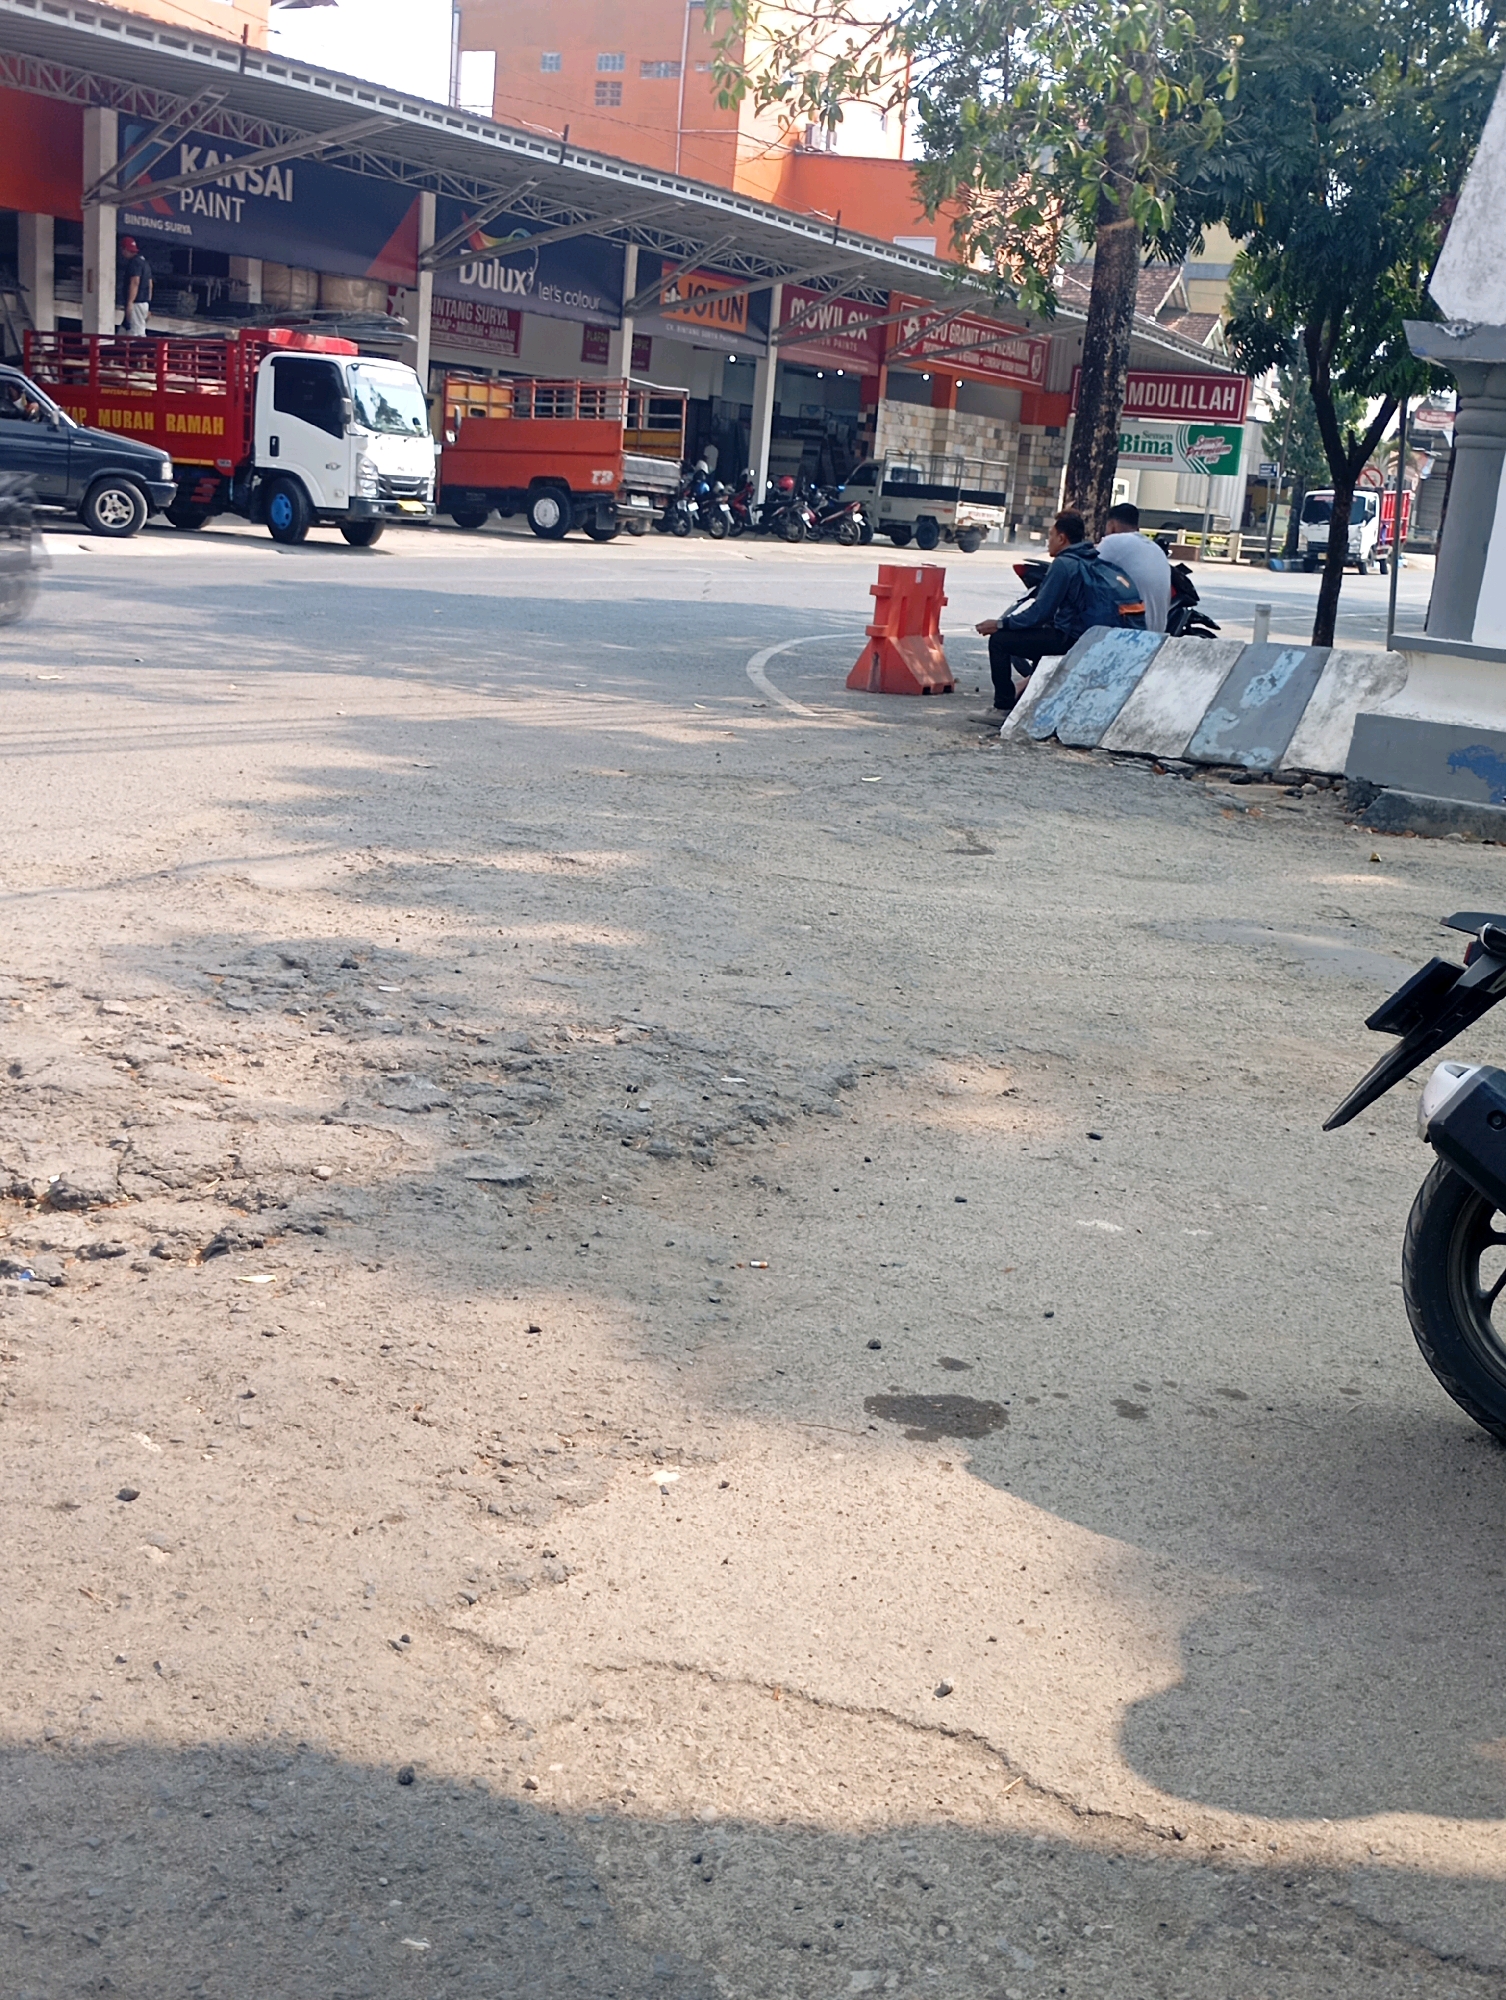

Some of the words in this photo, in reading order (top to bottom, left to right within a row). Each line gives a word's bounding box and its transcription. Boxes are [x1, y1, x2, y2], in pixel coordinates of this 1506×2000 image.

[180, 143, 293, 202] KANSAI
[180, 187, 245, 223] PAINT
[124, 213, 164, 230] BINTANG
[164, 221, 192, 235] SURYA
[459, 249, 527, 296] Dulux
[538, 281, 561, 302] let's
[564, 290, 601, 310] colour
[432, 296, 473, 321] INTANG
[475, 304, 509, 327] SURYA
[683, 282, 744, 324] JOTUN
[1126, 381, 1236, 411] MDULILLAH
[98, 409, 155, 431] MURAH
[166, 413, 224, 435] RAMAH
[1142, 430, 1173, 441] Semen
[1120, 433, 1173, 455] Bima
